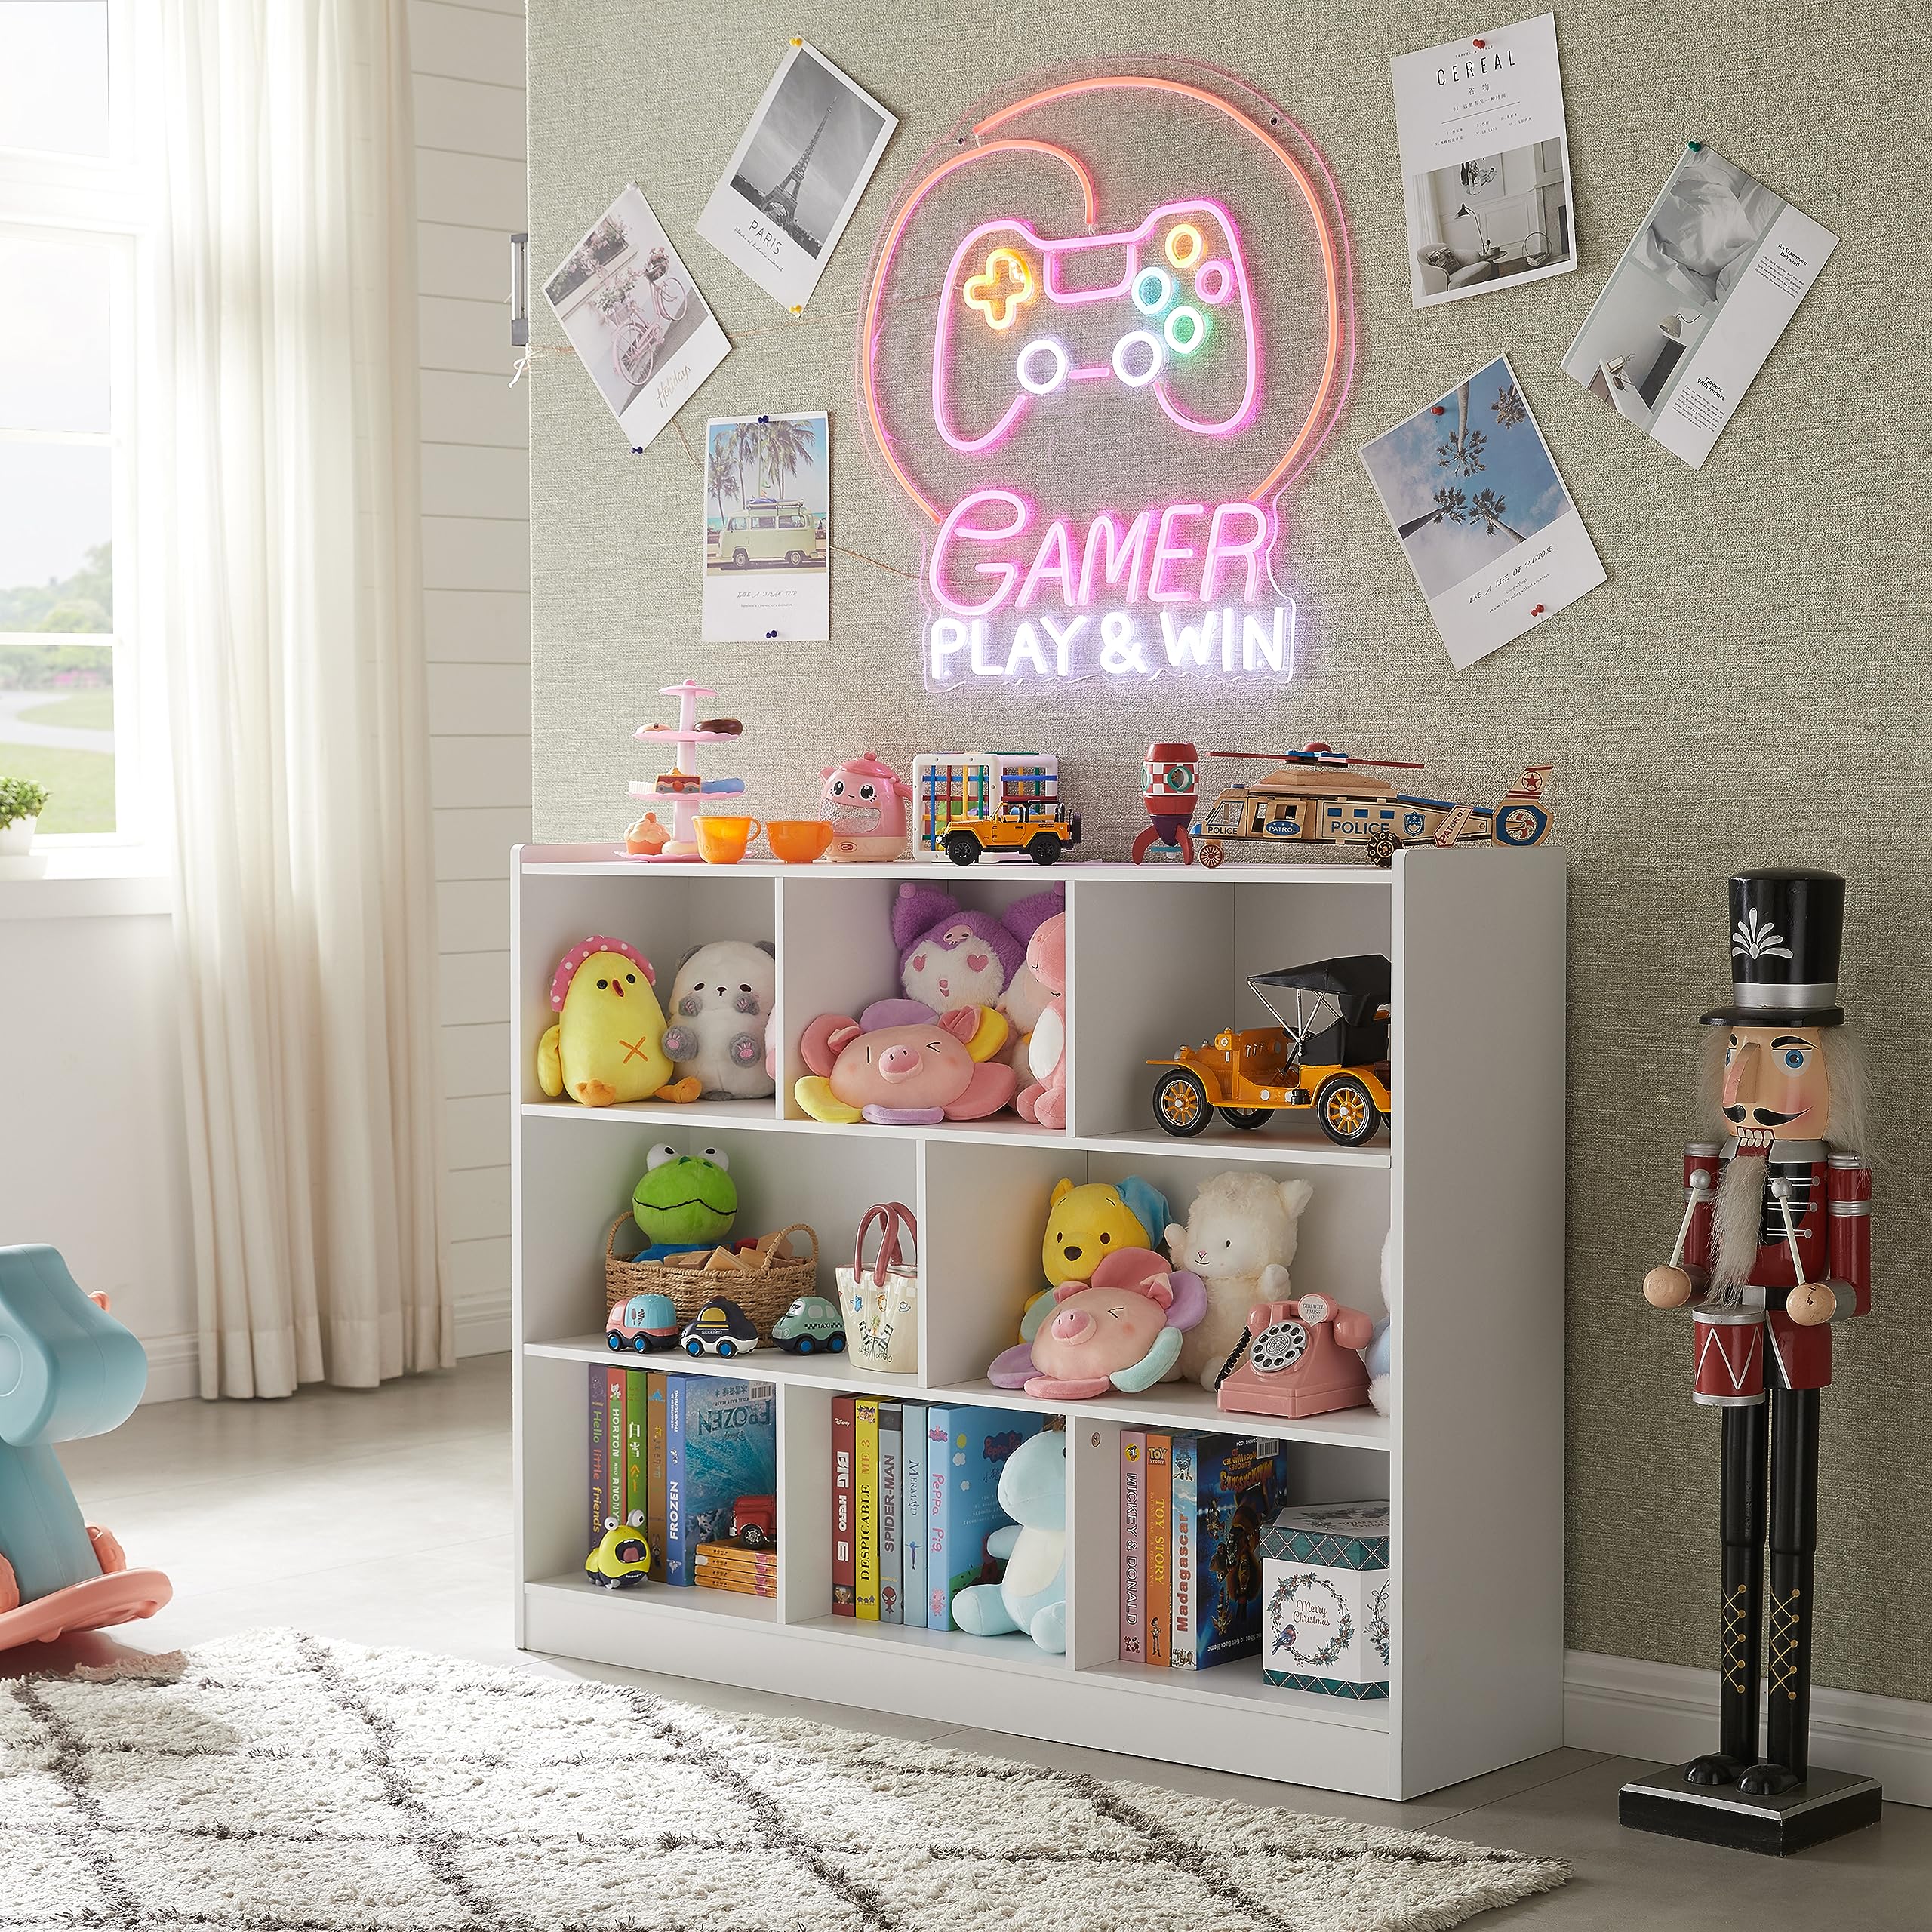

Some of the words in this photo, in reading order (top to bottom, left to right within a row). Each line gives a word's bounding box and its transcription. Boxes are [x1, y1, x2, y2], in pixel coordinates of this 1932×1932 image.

[1437, 50, 1515, 85] CEREAL
[749, 220, 783, 254] PARIS
[1780, 251, 1800, 267] Delivered
[1785, 248, 1807, 266] Experience
[1697, 378, 1709, 389] With
[1708, 387, 1725, 401] Impact
[1705, 377, 1723, 392] Flowers
[930, 489, 1267, 616] GAMER
[1495, 574, 1509, 588] LIFE
[931, 616, 1088, 679] PLAY
[1100, 611, 1146, 674] &
[1160, 607, 1284, 672] WIN
[1208, 826, 1238, 835] POLICE
[1268, 825, 1297, 834] PATROL
[1331, 820, 1390, 835] POLICE
[1439, 808, 1466, 844] PATROL
[1370, 832, 1395, 864] POLICE
[592, 1410, 602, 1444] Hello
[611, 1408, 620, 1457] HORTON
[698, 1400, 771, 1435] FROZEN
[862, 1439, 870, 1448] 3
[1149, 1447, 1167, 1460] TOY
[592, 1448, 602, 1481] little
[837, 1451, 849, 1488] BIG
[861, 1452, 871, 1475] ME
[1223, 1454, 1243, 1465] WANTED
[1220, 1470, 1227, 1491] 3
[1226, 1460, 1273, 1491] MADAGASCAR
[592, 1486, 604, 1533] friends
[884, 1454, 894, 1552] SPIDER-MAN
[932, 1473, 945, 1515] Peppa
[1125, 1473, 1138, 1537] MICKEY
[669, 1481, 678, 1540] FROZEN
[838, 1495, 848, 1531] HERO
[1155, 1499, 1164, 1529] TOY
[860, 1484, 871, 1581] DESPICABLE
[931, 1527, 945, 1552] Pig
[1126, 1541, 1138, 1552] &
[837, 1540, 849, 1562] 6
[1155, 1536, 1164, 1586] STORY
[1177, 1514, 1191, 1632] Madagascar
[1125, 1556, 1138, 1626] DONALD
[1291, 1609, 1331, 1627] Christmas
[1297, 1599, 1328, 1617] Merry
[1208, 1644, 1220, 1652] Home
[1220, 1640, 1232, 1649] Back
